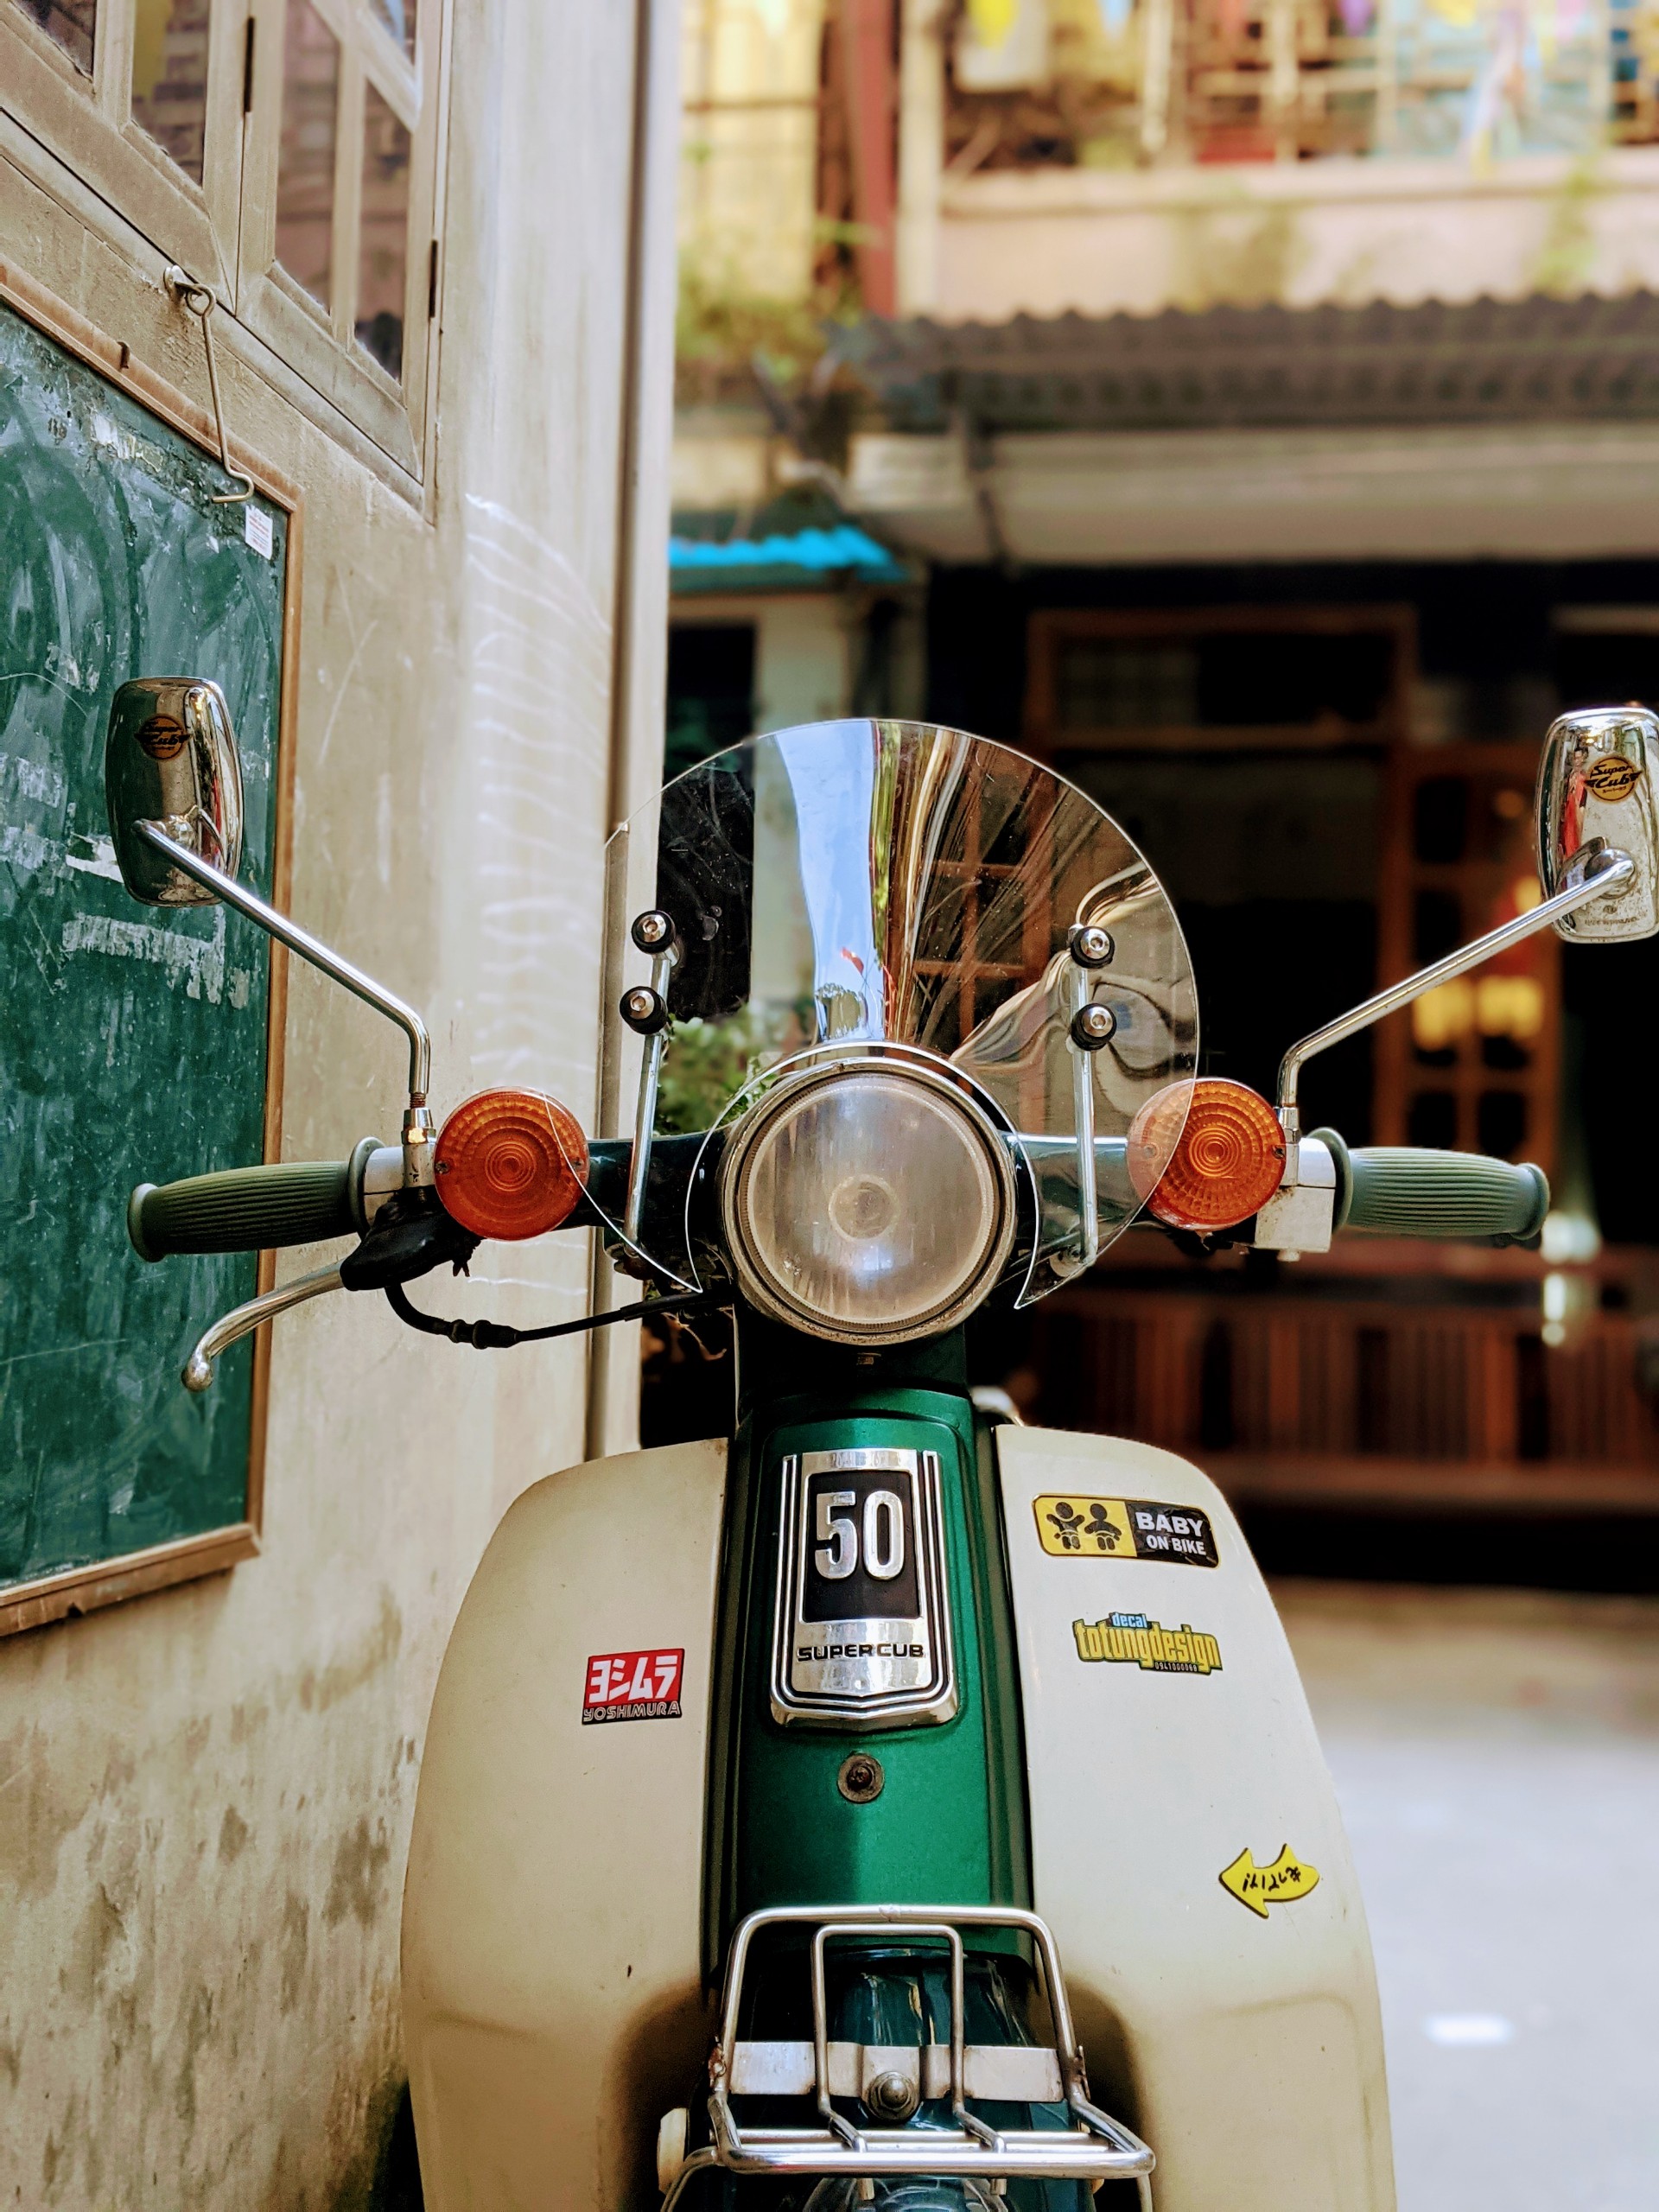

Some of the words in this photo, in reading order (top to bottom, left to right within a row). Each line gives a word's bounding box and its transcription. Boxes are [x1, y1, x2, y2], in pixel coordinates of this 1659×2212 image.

[1590, 764, 1632, 779] Super
[1595, 773, 1630, 788] Cub
[1135, 1512, 1203, 1537] BABY
[815, 1491, 905, 1580] 50
[1147, 1535, 1170, 1550] ON
[1173, 1538, 1206, 1555] BIKE
[1112, 1612, 1147, 1628] decal
[588, 1656, 678, 1703] ヨシムラ
[583, 1700, 681, 1722] YOSHIMURA
